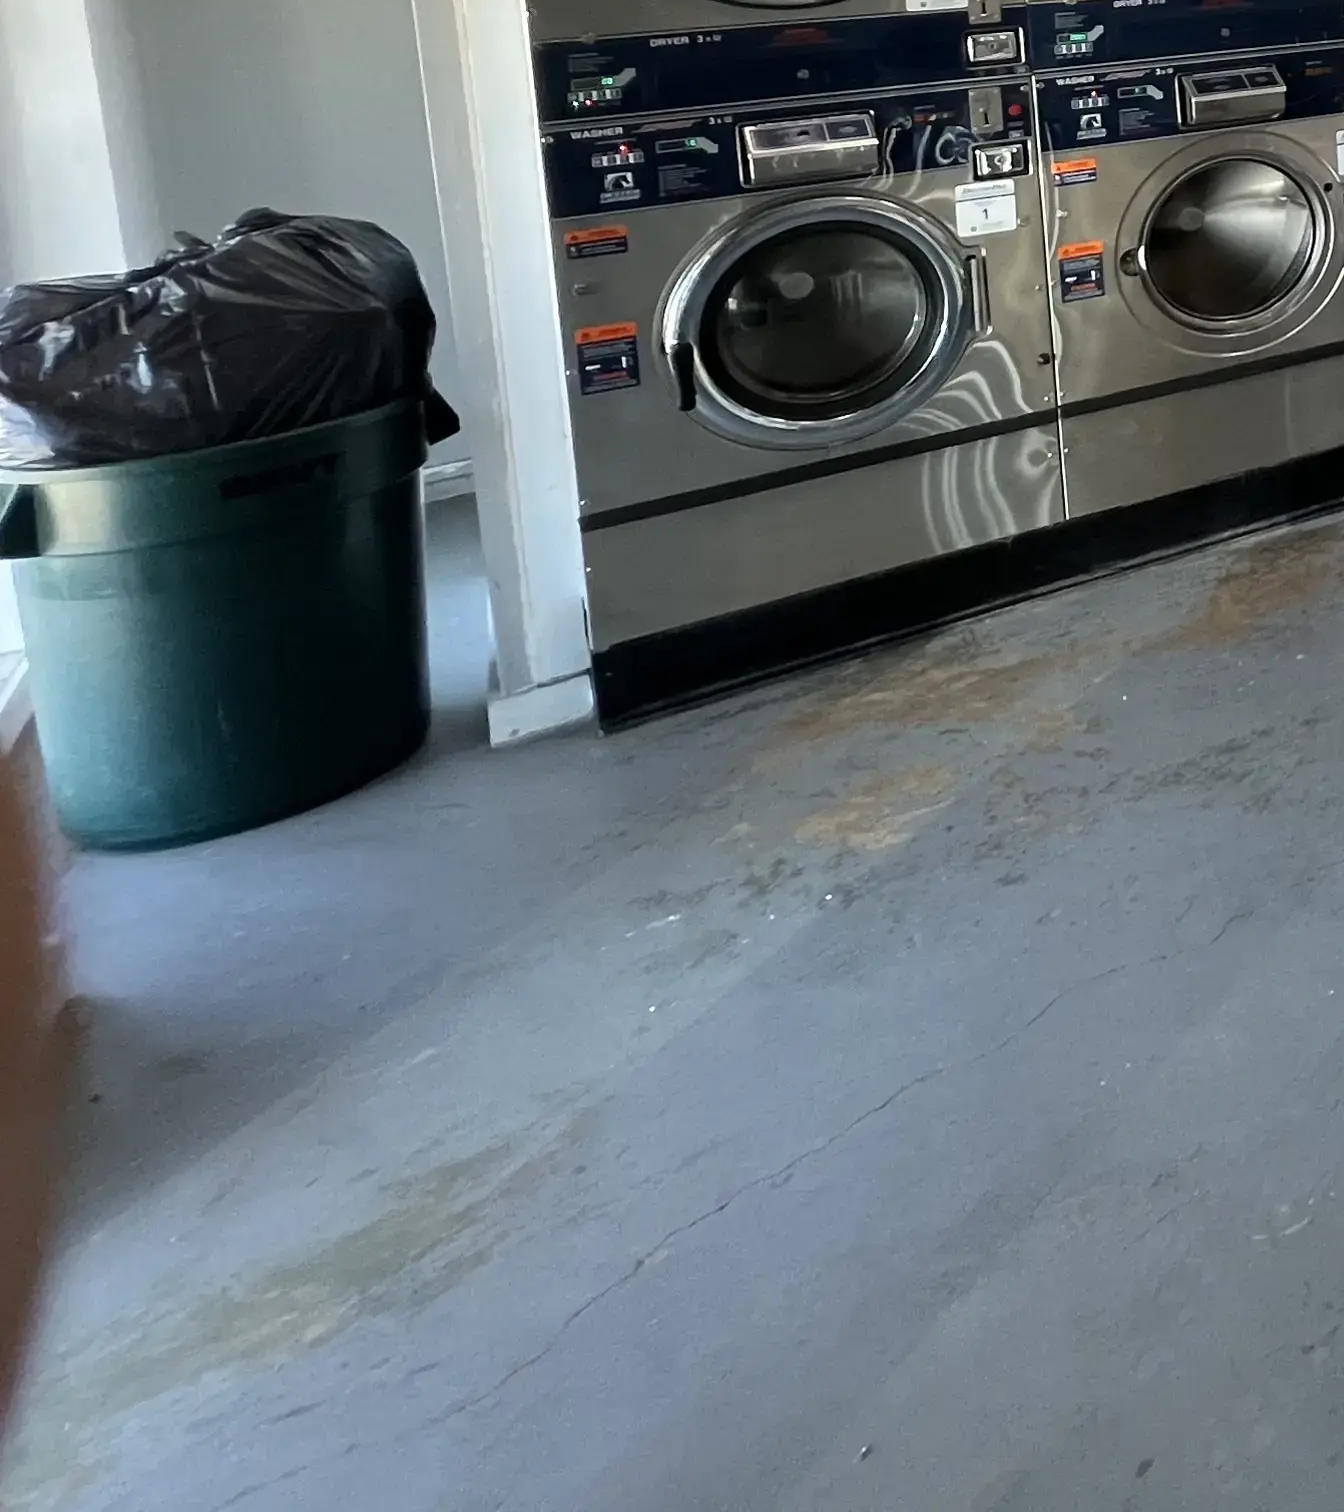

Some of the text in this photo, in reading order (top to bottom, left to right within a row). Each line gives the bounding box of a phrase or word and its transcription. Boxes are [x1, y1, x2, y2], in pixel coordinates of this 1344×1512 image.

[649, 35, 691, 48] DRYER
[569, 125, 624, 140] WASHER
[982, 207, 989, 220] 1
